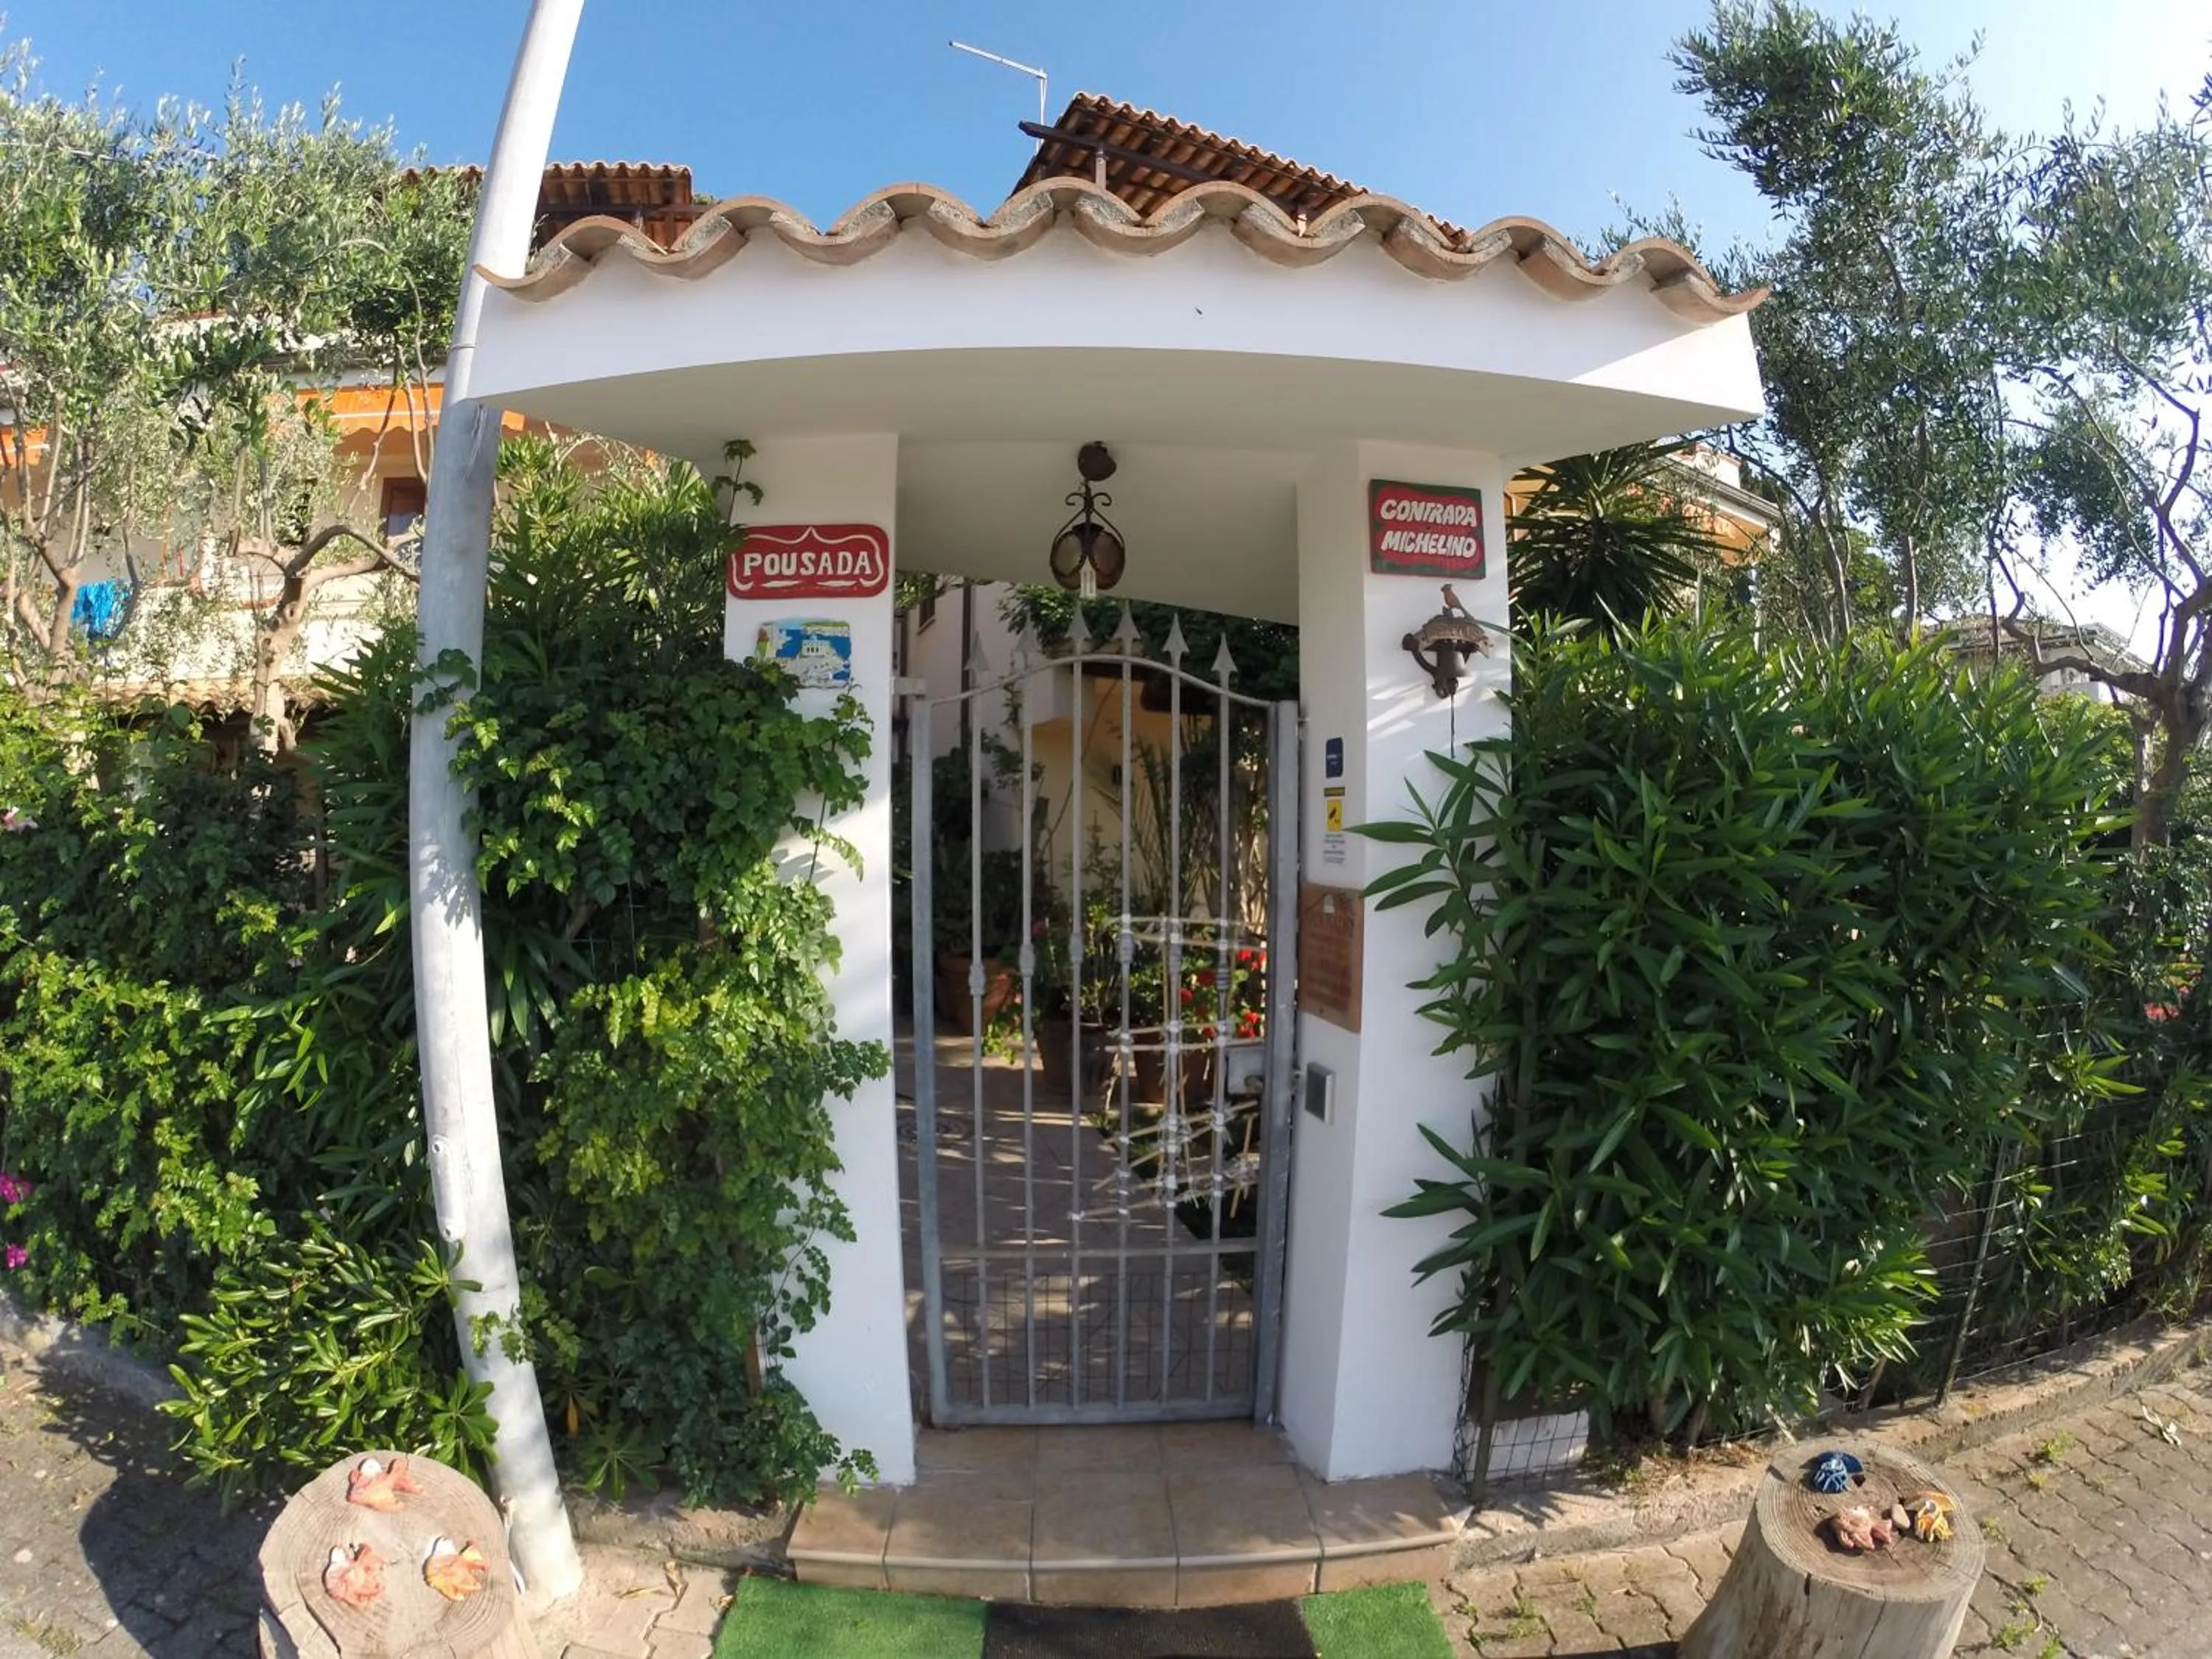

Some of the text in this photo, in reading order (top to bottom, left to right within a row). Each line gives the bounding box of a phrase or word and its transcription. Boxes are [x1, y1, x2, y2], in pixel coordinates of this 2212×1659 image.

[1380, 499, 1477, 527] CONTRADA
[1380, 530, 1477, 558] MICHELINO
[743, 552, 873, 577] POUSADA
